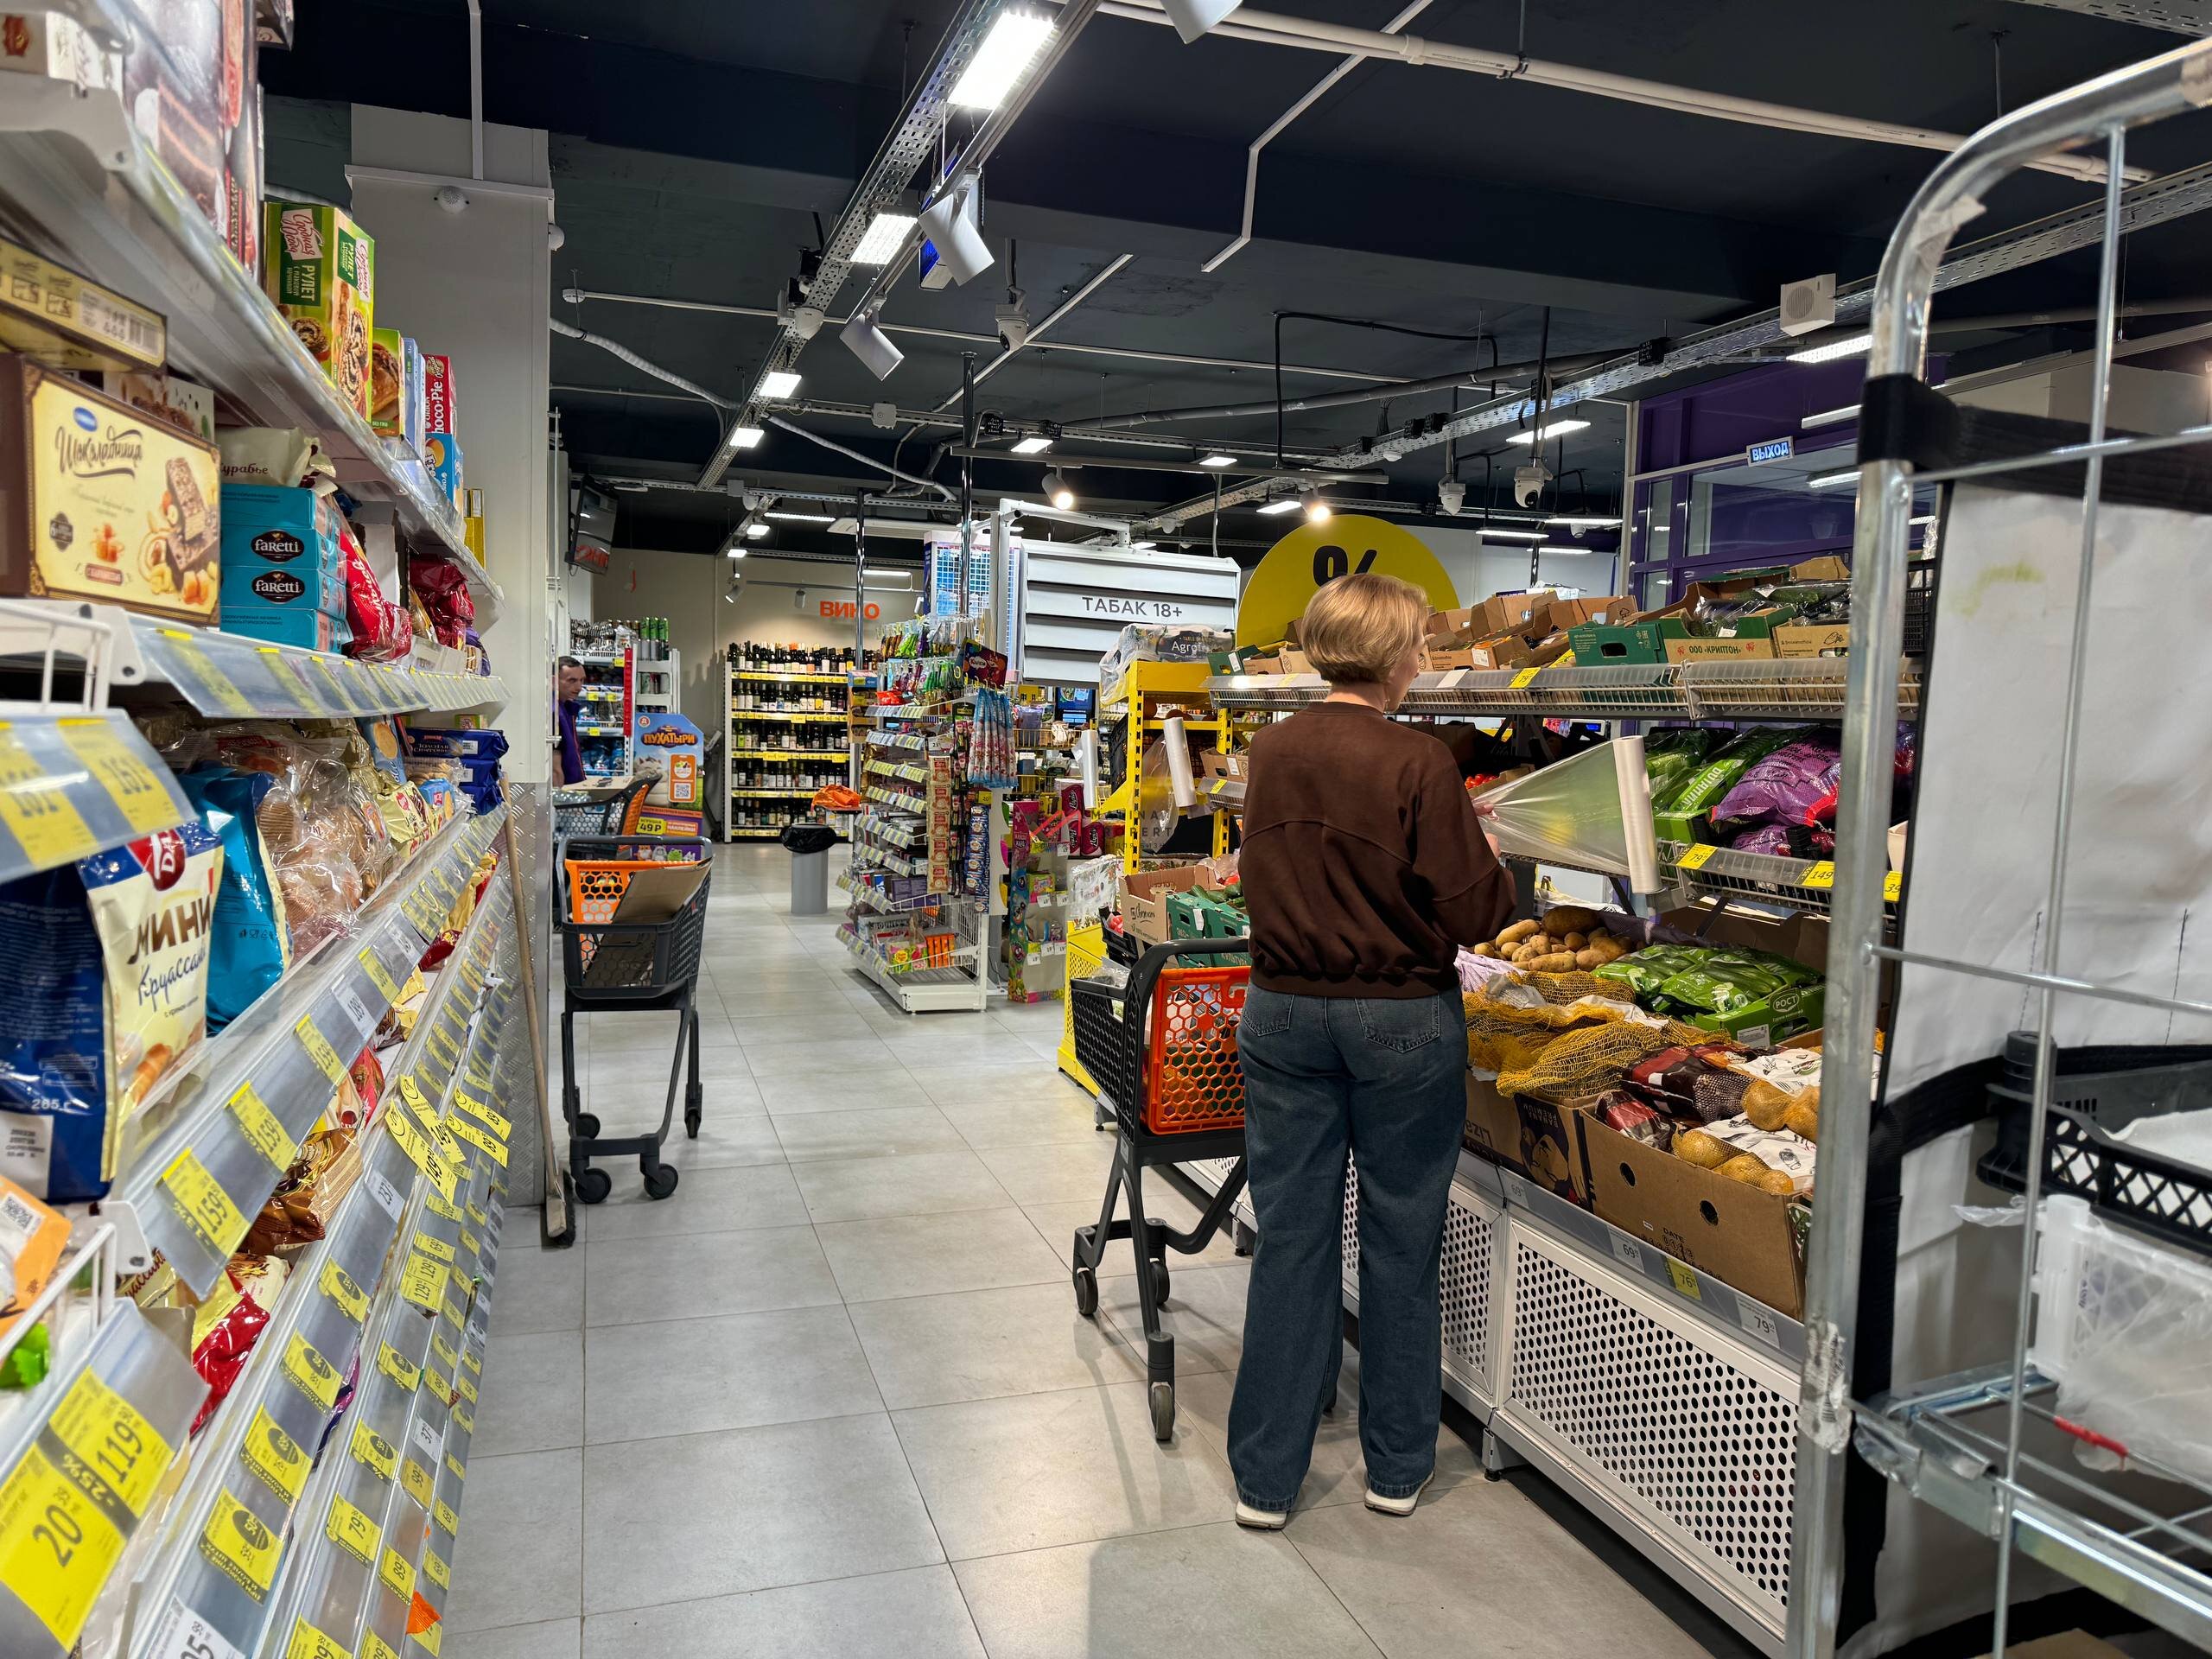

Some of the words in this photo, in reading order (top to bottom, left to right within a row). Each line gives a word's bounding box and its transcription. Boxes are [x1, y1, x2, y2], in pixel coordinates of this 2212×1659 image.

[301, 264, 315, 302] РУЛЕТ
[1751, 440, 1789, 462] ВЫХОД
[1082, 596, 1147, 617] ТАБАК
[1153, 602, 1183, 618] 18+
[1688, 645, 1703, 654] ООО
[644, 732, 696, 745] ПУХАТЫРИ
[639, 823, 654, 832] 49
[1688, 852, 1704, 863] 79
[1810, 870, 1834, 880] 149
[127, 893, 211, 964] МИНИ
[1775, 995, 1798, 1010] РОСТ
[32, 1098, 61, 1111] 285
[256, 1118, 282, 1154] 159
[425, 1154, 442, 1187] 149
[196, 1191, 228, 1235] 159
[1663, 1227, 1685, 1243] DATE
[1623, 1243, 1635, 1259] 69
[421, 1261, 436, 1279] 129
[1679, 1273, 1693, 1288] 76
[414, 1282, 431, 1301] 129
[1753, 1315, 1770, 1334] 79
[421, 1427, 432, 1445] 37
[97, 1420, 143, 1484] 119
[62, 1453, 116, 1507] -25%
[33, 1503, 83, 1568] 20
[348, 1516, 366, 1541] 79
[393, 1562, 406, 1581] 89
